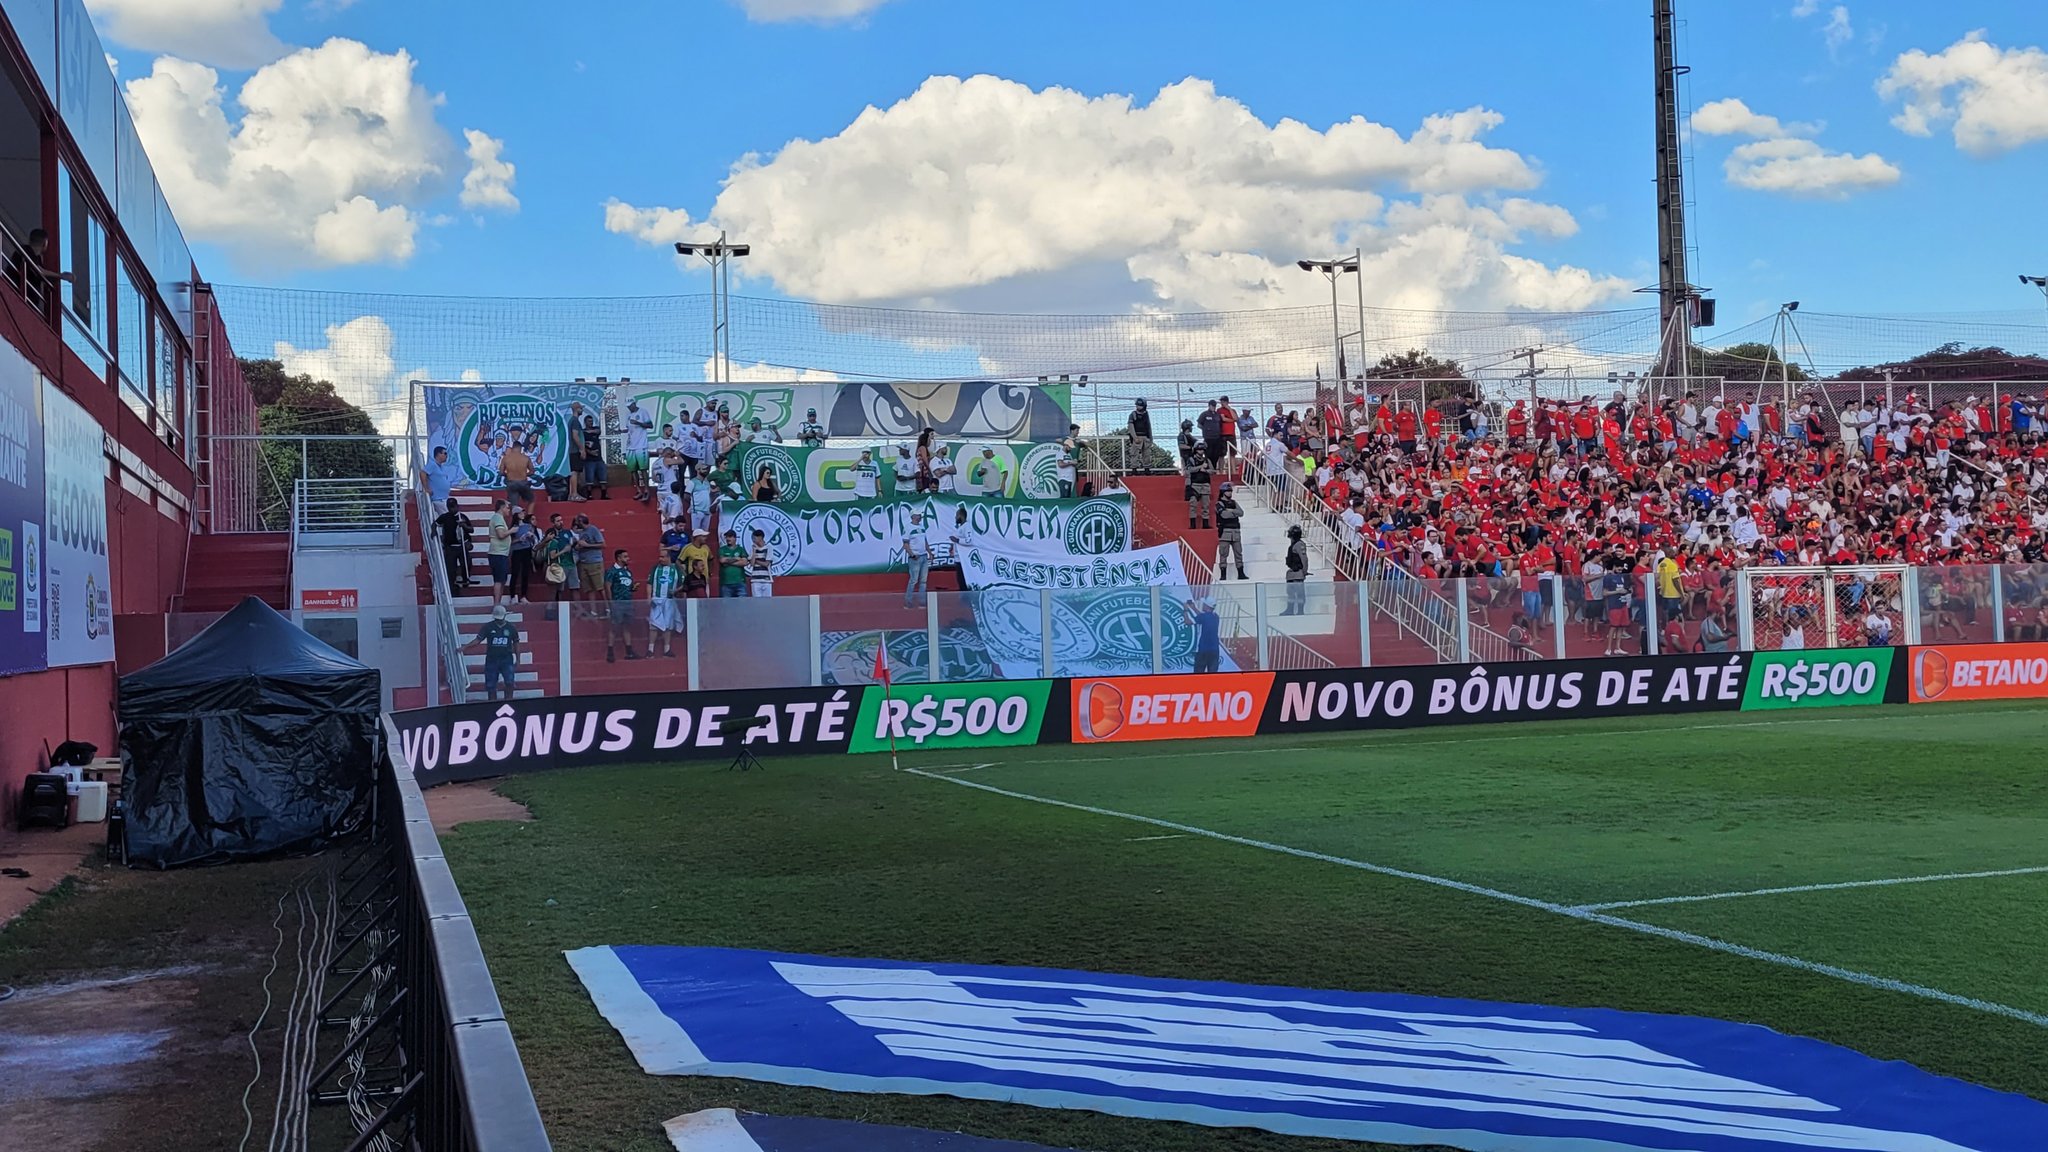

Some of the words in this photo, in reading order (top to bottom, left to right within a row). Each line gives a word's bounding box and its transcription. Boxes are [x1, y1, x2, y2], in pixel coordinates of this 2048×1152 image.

[478, 402, 556, 427] BUGRINOS
[955, 500, 1062, 540] OVEM
[1068, 510, 1084, 543] GUARANI
[1083, 504, 1113, 516] FUTEBOL
[1113, 513, 1124, 538] CLUBE
[993, 555, 1171, 589] RESISTÊNCIA
[1279, 679, 1414, 723] NOVO
[1428, 665, 1584, 715] BÔNUS
[1596, 669, 1653, 706] DE
[1661, 655, 1743, 703] ATÉ
[1760, 659, 1876, 702] R$500
[1952, 657, 2048, 688] BETANO
[1129, 690, 1253, 725] BETANO
[448, 703, 637, 765] BÔNUS
[653, 705, 730, 749] DE
[745, 689, 850, 745] ATÉ
[875, 694, 1028, 744] R$500
